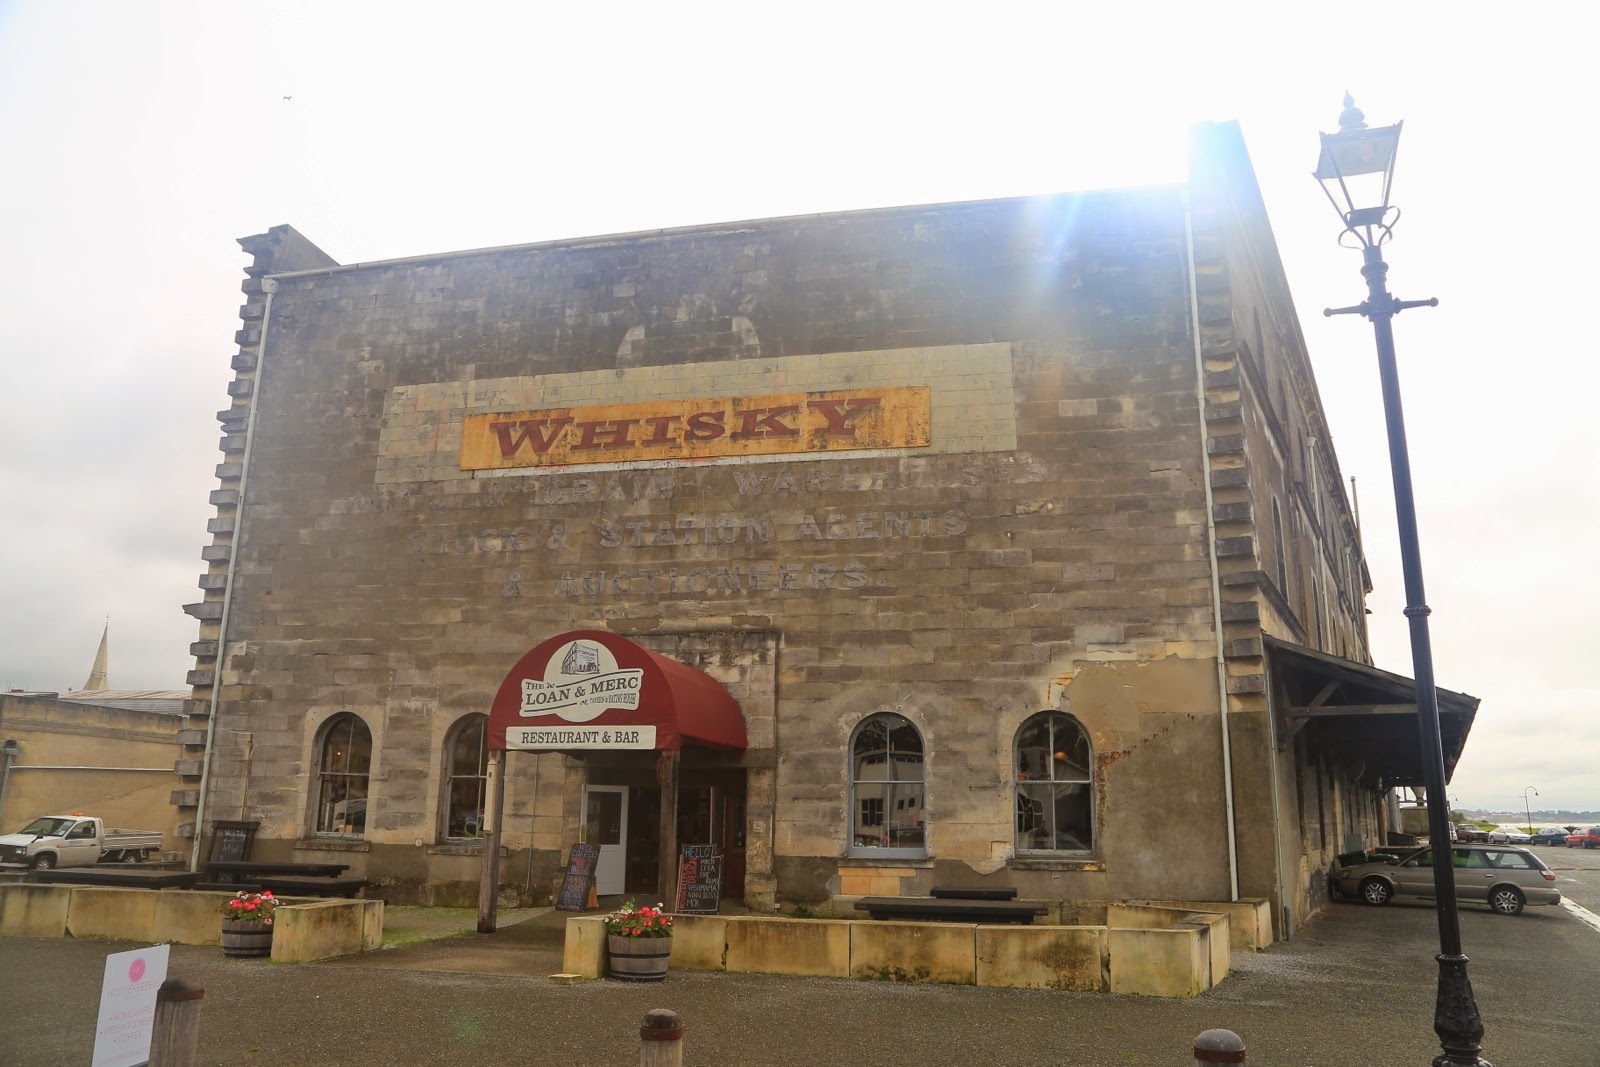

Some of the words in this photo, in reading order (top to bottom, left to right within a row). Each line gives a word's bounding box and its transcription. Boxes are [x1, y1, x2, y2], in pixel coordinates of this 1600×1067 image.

[489, 396, 884, 458] WHISKY
[600, 512, 770, 548] STATION
[795, 510, 969, 541] AGENTS
[525, 681, 545, 690] THE
[525, 688, 570, 705] LOAN
[574, 686, 586, 698] &
[590, 677, 639, 694] MERC
[521, 731, 599, 744] RESTAURANT
[602, 731, 612, 744] &
[614, 731, 640, 744] BAR
[117, 1029, 144, 1044] COFFEE
